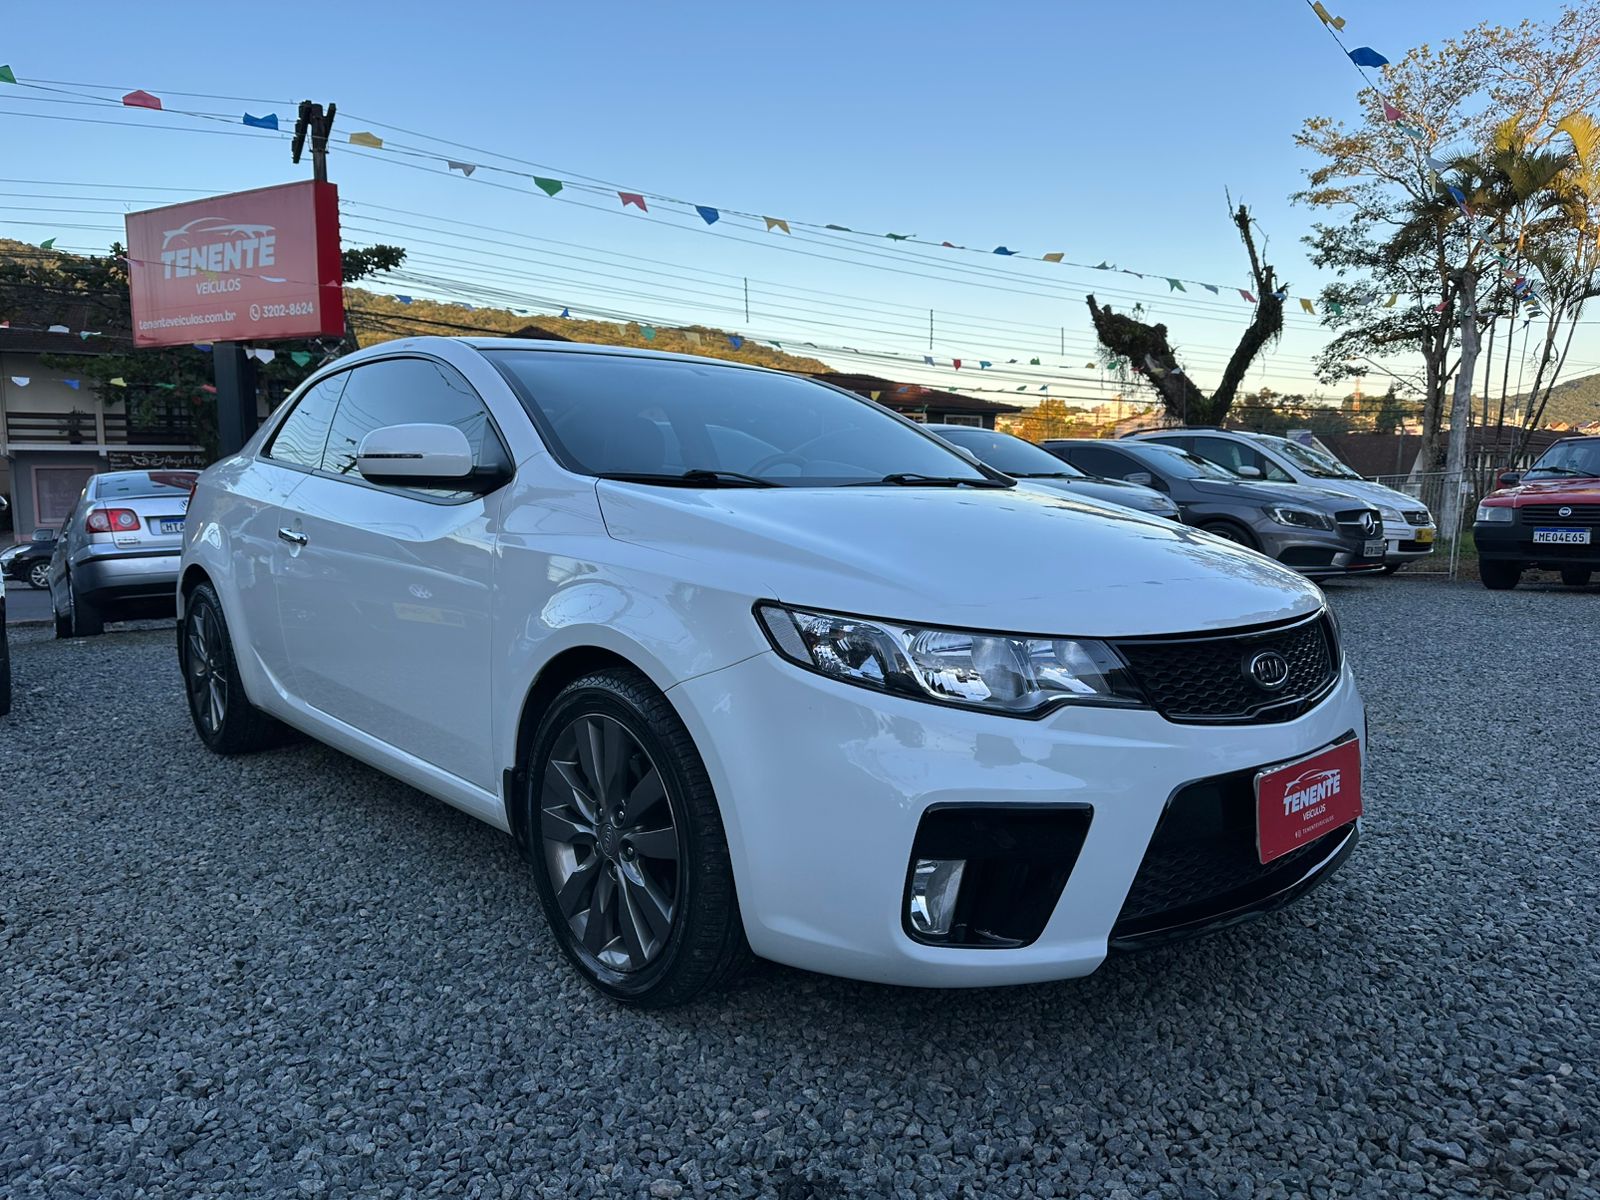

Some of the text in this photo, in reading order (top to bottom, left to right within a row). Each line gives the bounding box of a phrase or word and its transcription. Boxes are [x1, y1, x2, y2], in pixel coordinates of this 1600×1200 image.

[161, 236, 276, 279] TENENTE
[262, 301, 314, 318] 3202-8624
[1256, 658, 1284, 681] KIA
[1283, 775, 1341, 816] TENENTE
